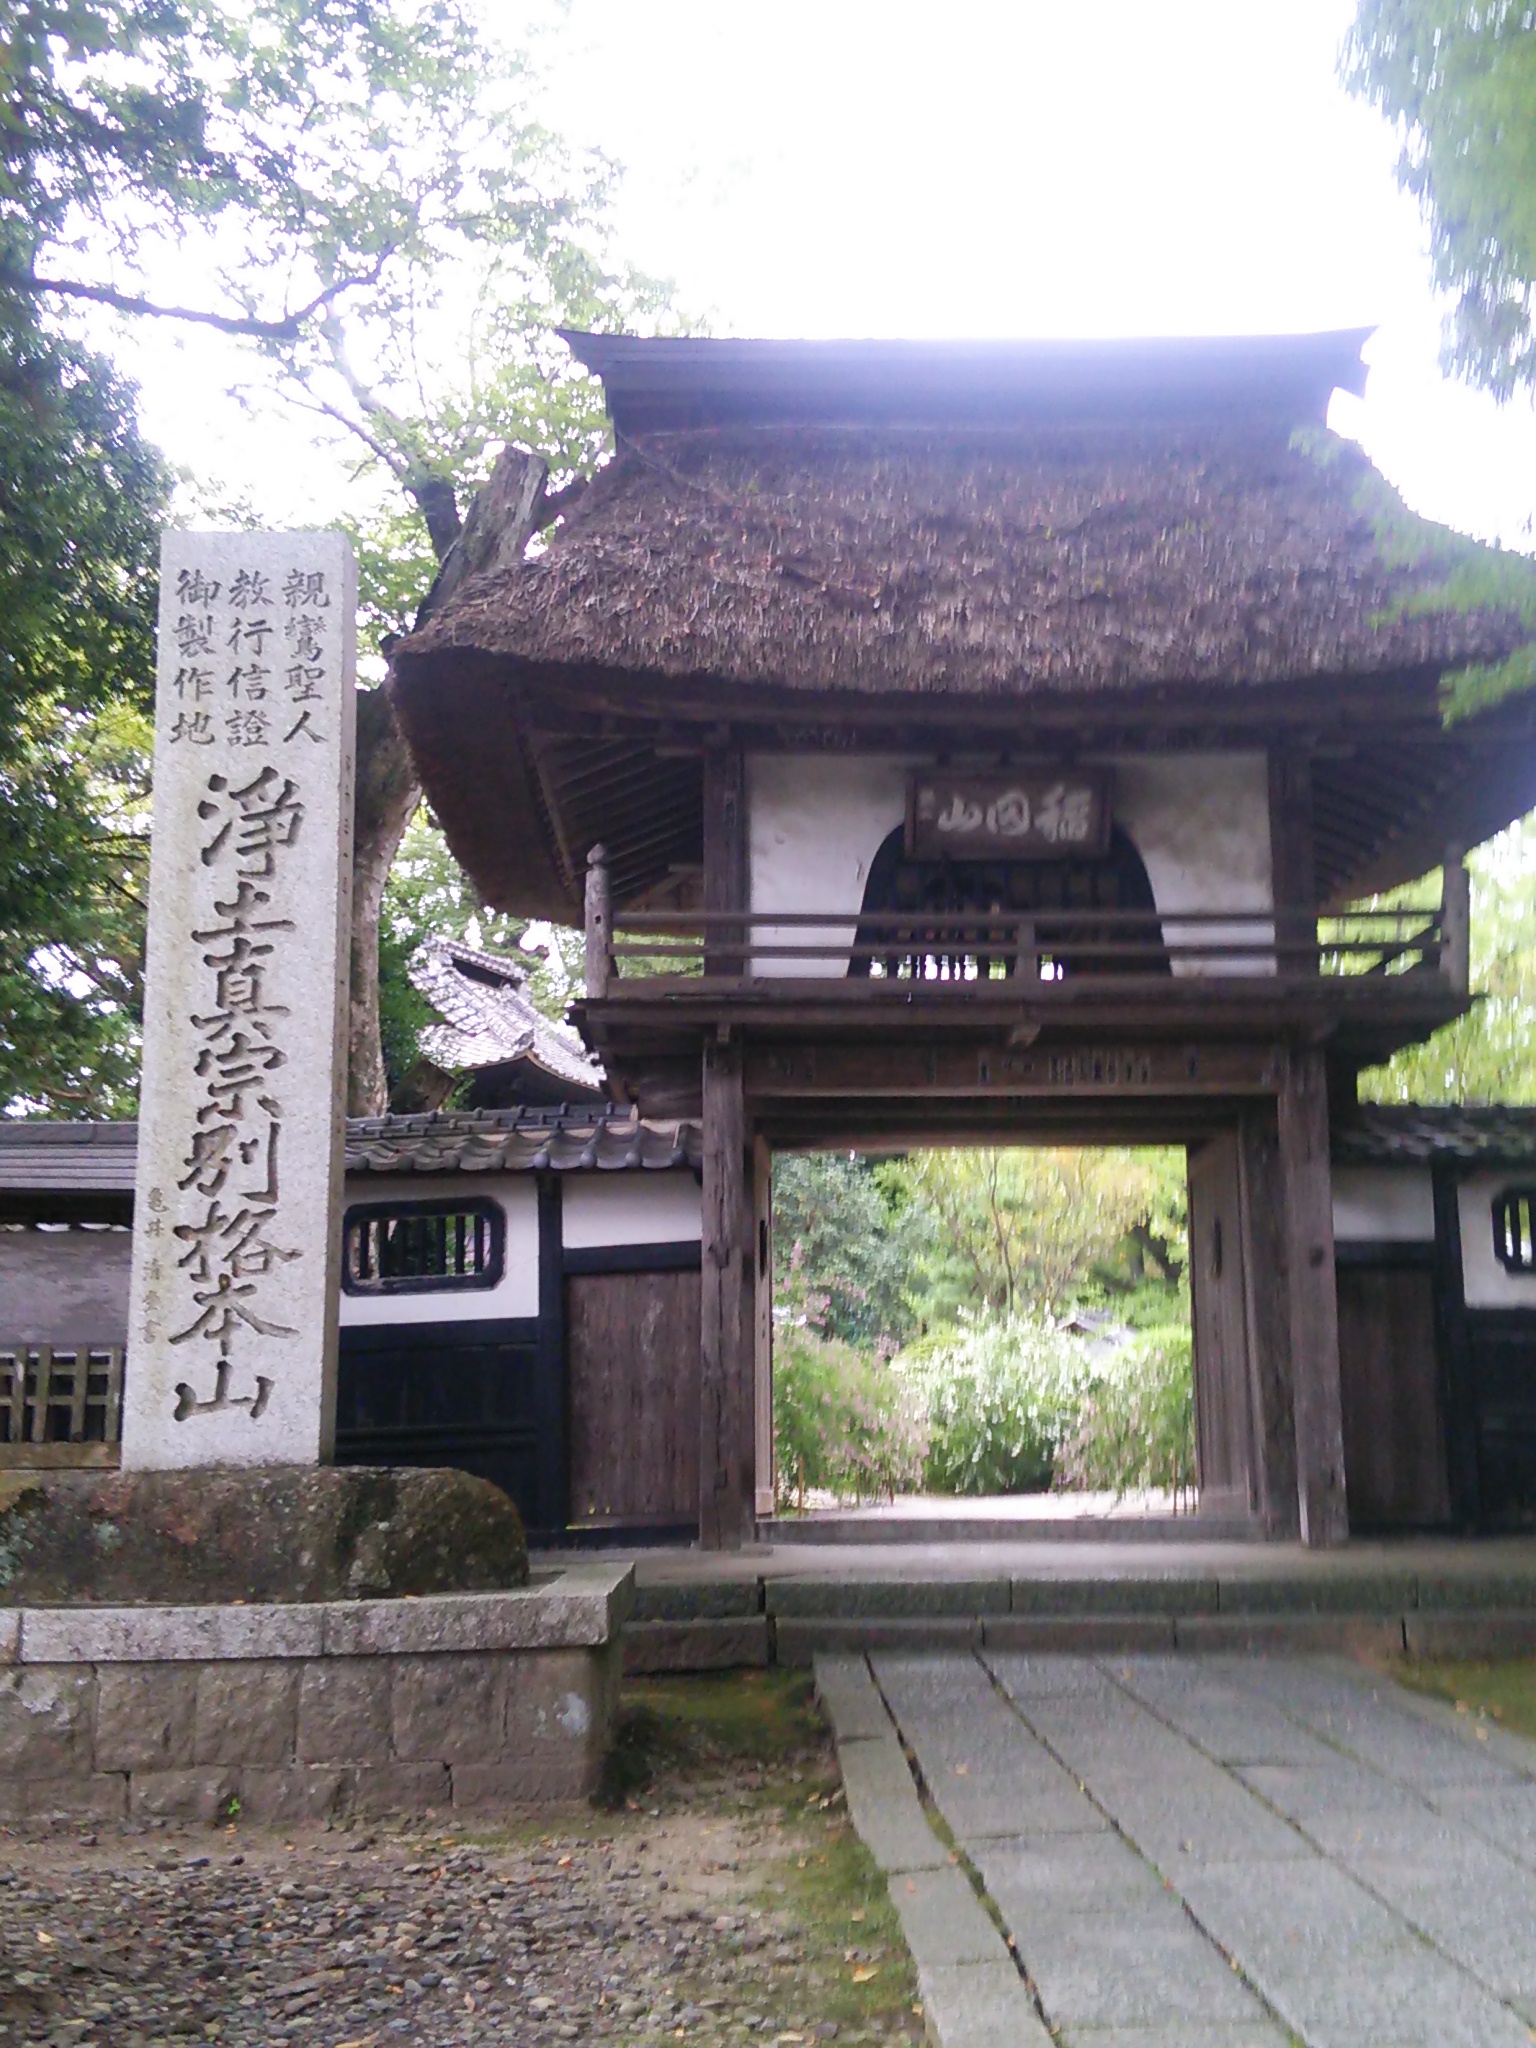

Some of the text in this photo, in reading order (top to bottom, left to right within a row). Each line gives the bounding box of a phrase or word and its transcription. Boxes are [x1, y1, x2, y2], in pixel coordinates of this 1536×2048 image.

[169, 567, 223, 745] 御製作地
[224, 567, 275, 748] 教行信證
[281, 567, 332, 744] 親鸞聖人
